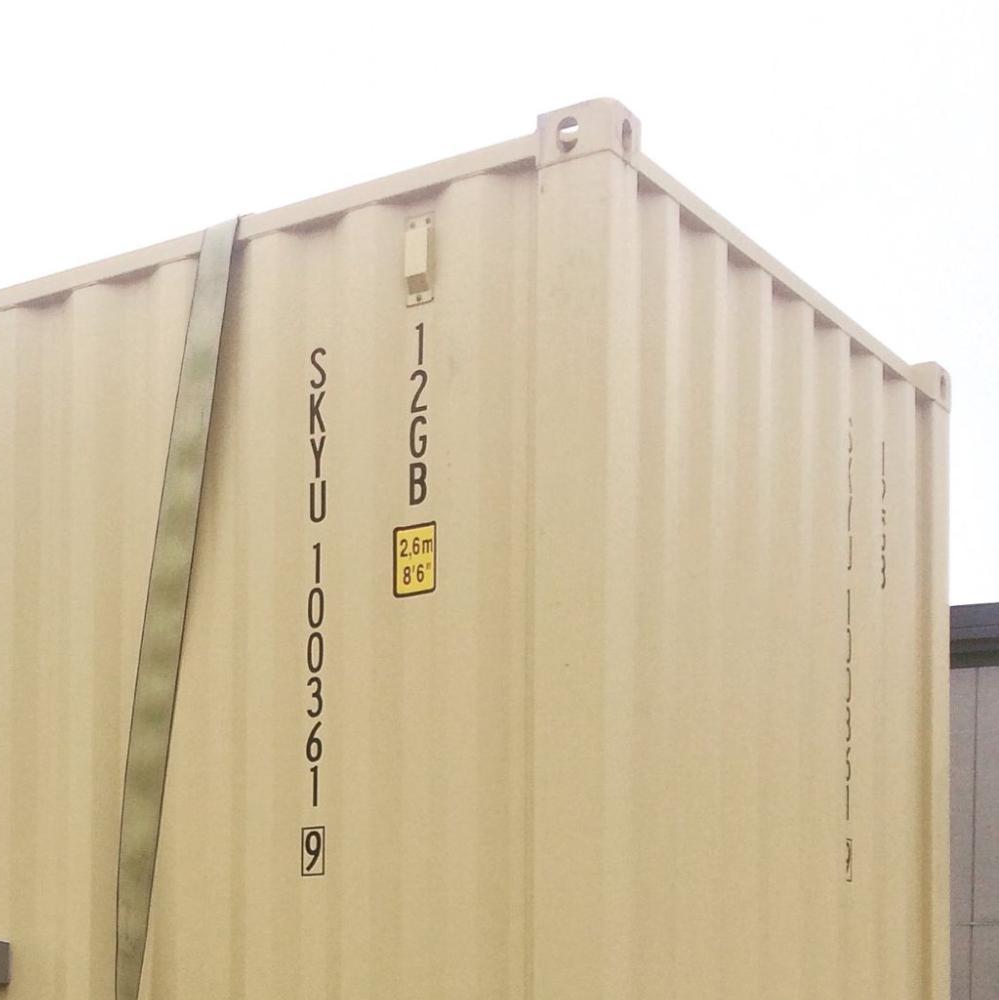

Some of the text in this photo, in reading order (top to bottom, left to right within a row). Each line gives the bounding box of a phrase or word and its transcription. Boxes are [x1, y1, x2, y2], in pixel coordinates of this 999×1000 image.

[309, 347, 327, 523] SKYU
[408, 322, 428, 506] 12GB
[306, 541, 325, 807] 100361
